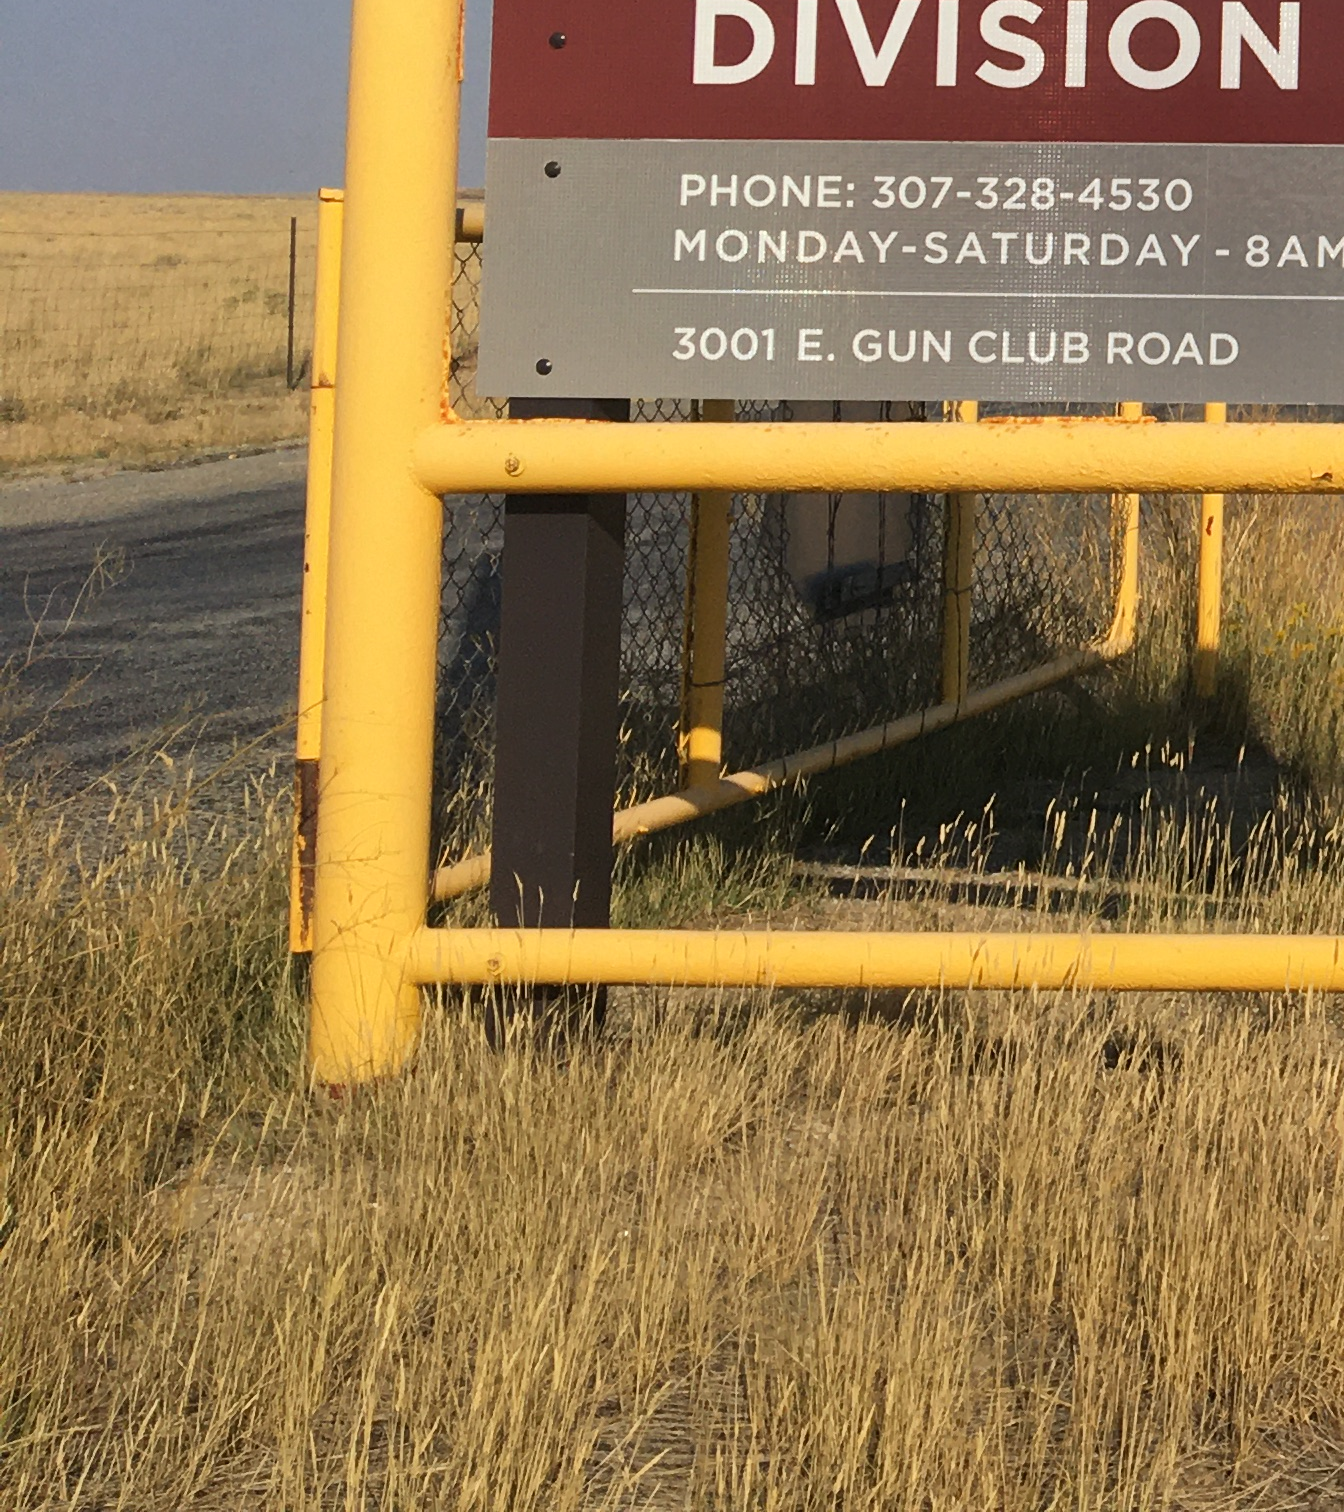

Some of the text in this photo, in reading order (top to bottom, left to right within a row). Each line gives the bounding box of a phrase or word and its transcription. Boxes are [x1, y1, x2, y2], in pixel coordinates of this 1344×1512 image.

[679, 172, 1194, 212] PHONE: 307-328-4530
[672, 227, 1201, 268] MONDAY-SATURDAY
[671, 326, 1240, 367] 3001 E. GUN CLUB ROAD
